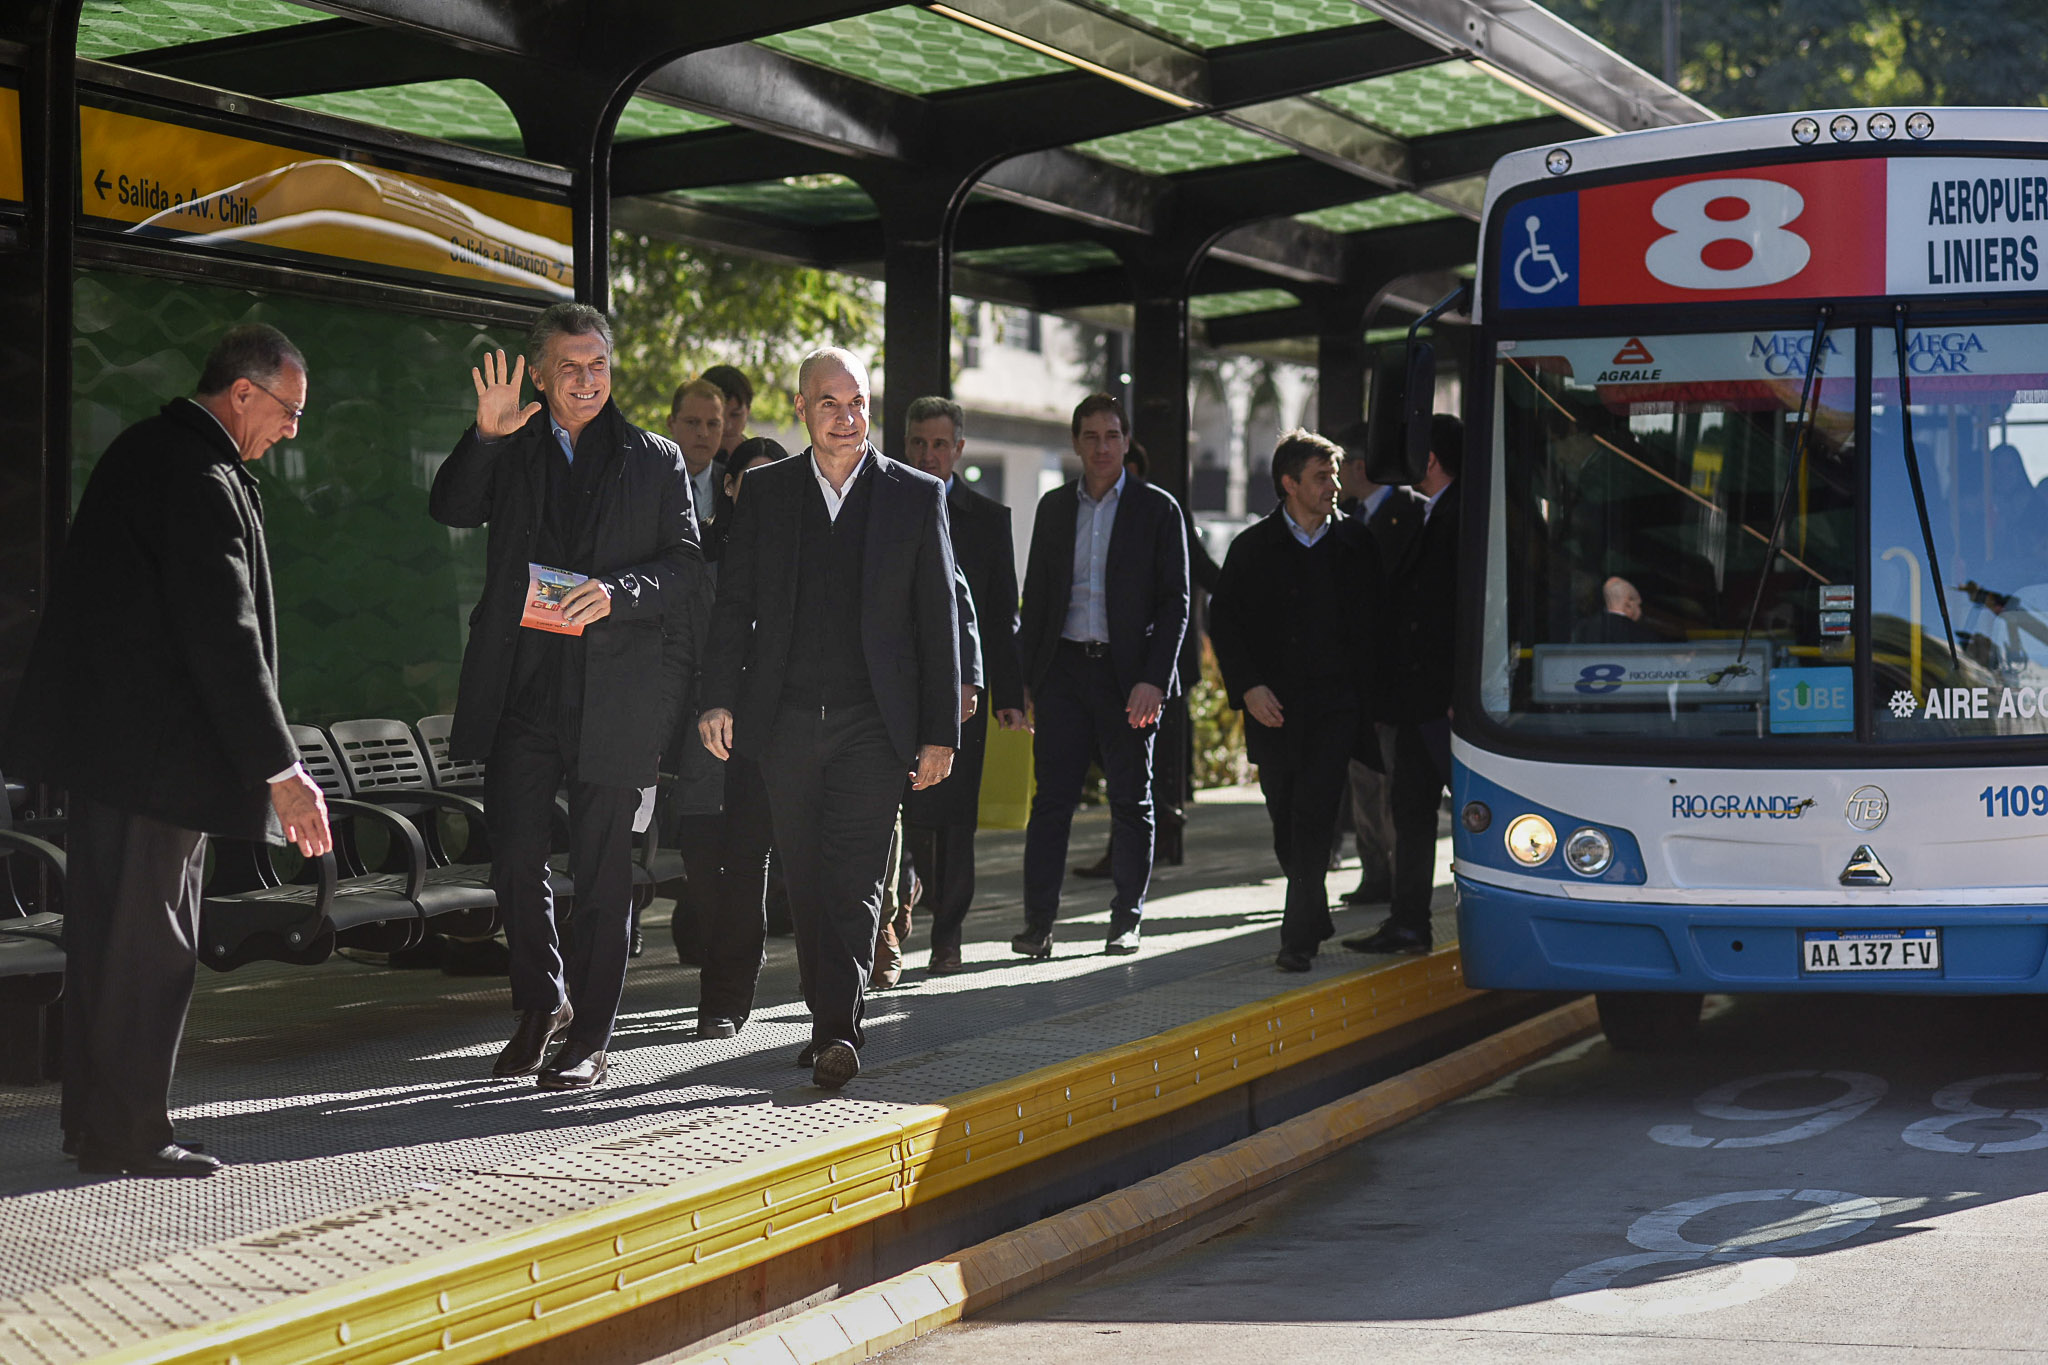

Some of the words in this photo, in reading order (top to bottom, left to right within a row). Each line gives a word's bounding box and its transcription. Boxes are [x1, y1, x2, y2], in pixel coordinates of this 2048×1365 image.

[118, 174, 169, 212] Salida
[174, 193, 183, 214] a
[188, 188, 214, 219] Av.
[219, 193, 258, 226] Chile
[1928, 177, 2048, 226] AEROPUER
[1645, 178, 1811, 290] 8
[450, 236, 489, 268] Salida
[1928, 235, 2039, 285] LINIERS
[1894, 331, 1987, 355] MEGA
[1597, 369, 1662, 382] AGRALE
[1908, 352, 1973, 374] CAR
[1574, 664, 1626, 694] 8
[1776, 687, 1846, 711] SUBE
[1923, 688, 1989, 719] AIRE
[1980, 785, 2048, 817] 1109
[1811, 943, 1840, 967] AA
[1848, 942, 1893, 966] 137
[1902, 941, 1931, 965] FV
